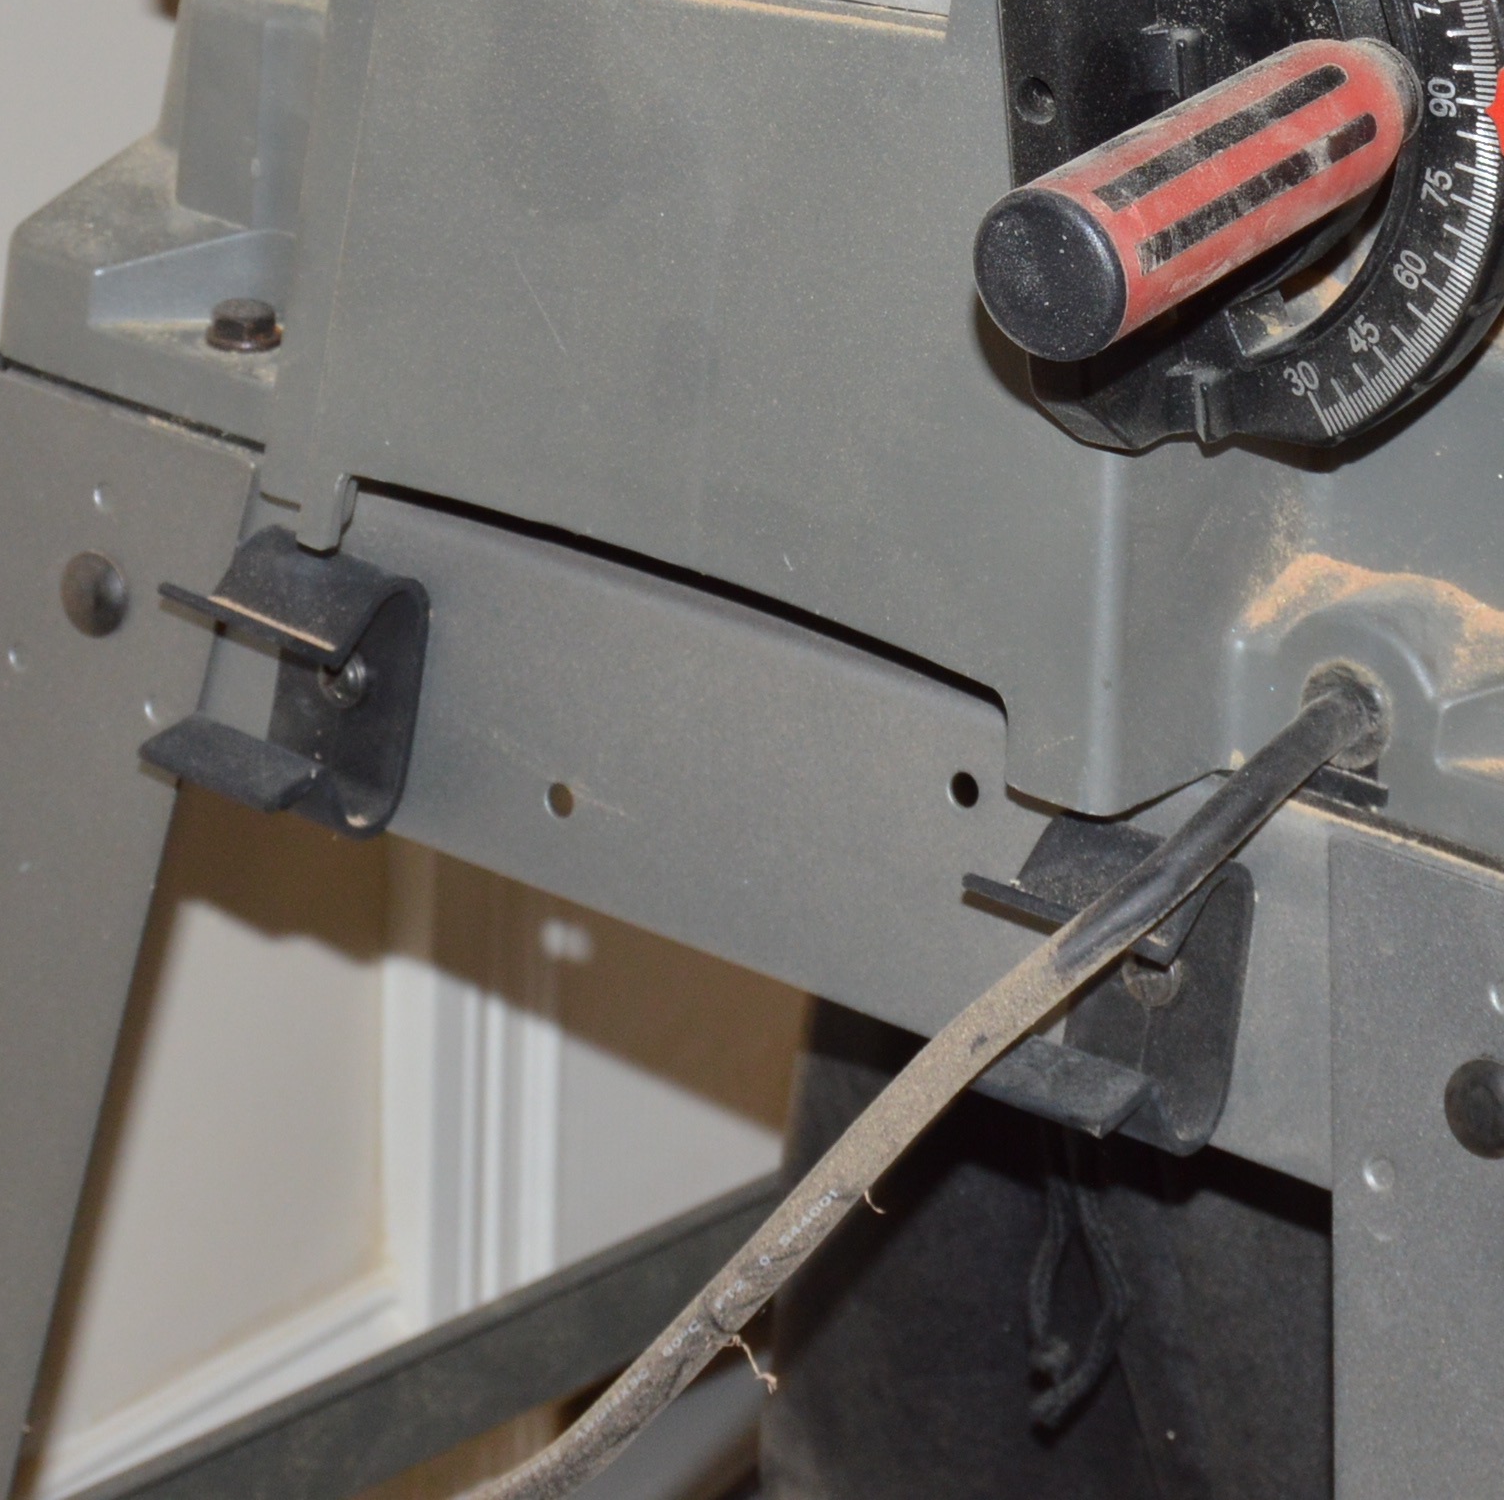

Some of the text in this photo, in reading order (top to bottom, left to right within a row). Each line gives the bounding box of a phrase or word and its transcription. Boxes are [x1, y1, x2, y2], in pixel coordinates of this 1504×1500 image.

[1426, 76, 1457, 119] 90
[1419, 166, 1454, 208] 75
[1392, 249, 1428, 291] 60
[1346, 314, 1381, 355] 45
[1283, 360, 1320, 398] 30
